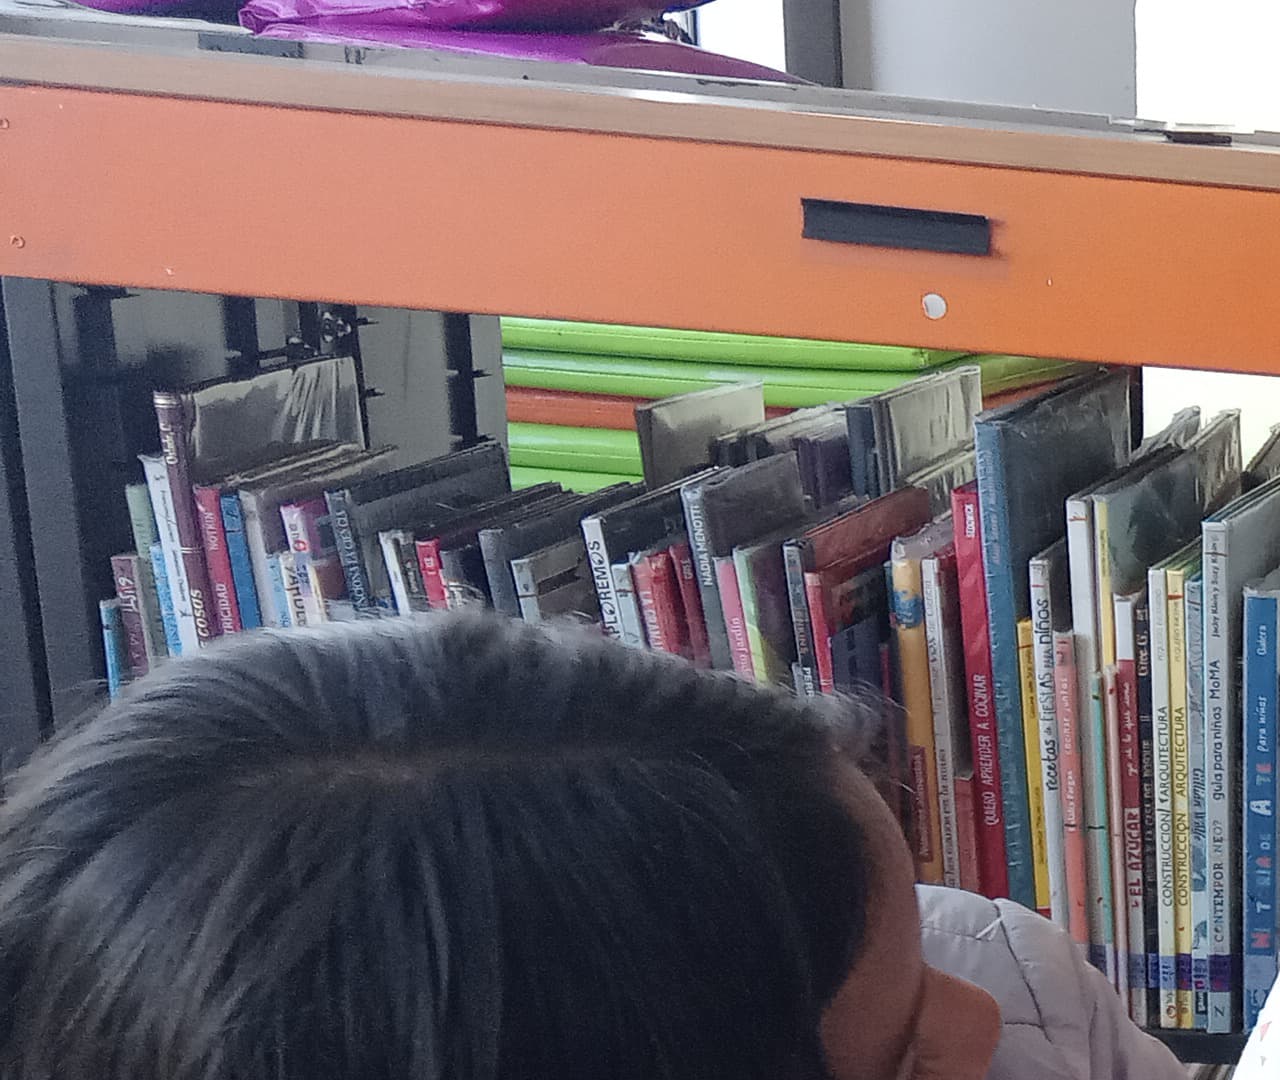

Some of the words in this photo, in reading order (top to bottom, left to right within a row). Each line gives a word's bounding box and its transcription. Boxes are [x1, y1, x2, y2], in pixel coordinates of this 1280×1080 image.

[204, 512, 219, 550] NOTKIN
[690, 505, 710, 551] MENOTTI
[696, 553, 712, 586] NADIA
[191, 589, 210, 638] cosas
[1034, 600, 1050, 644] niños
[732, 617, 747, 652] jardín
[973, 675, 989, 717] COCINAR
[1209, 660, 1221, 699] MoMA
[977, 722, 989, 730] A
[1209, 706, 1223, 739] niños
[1255, 696, 1267, 724] niños
[1157, 706, 1170, 796] ARQUITECTURA
[1173, 707, 1186, 797] ARQUITECTURA
[1212, 742, 1225, 771] para
[1256, 728, 1269, 752] para
[977, 734, 994, 785] APRENDER
[1041, 740, 1058, 791] recetas
[983, 792, 999, 825] QUIERO
[1142, 803, 1153, 826] CASA
[1124, 811, 1140, 871] AZÚCAR
[1128, 878, 1141, 896] EL
